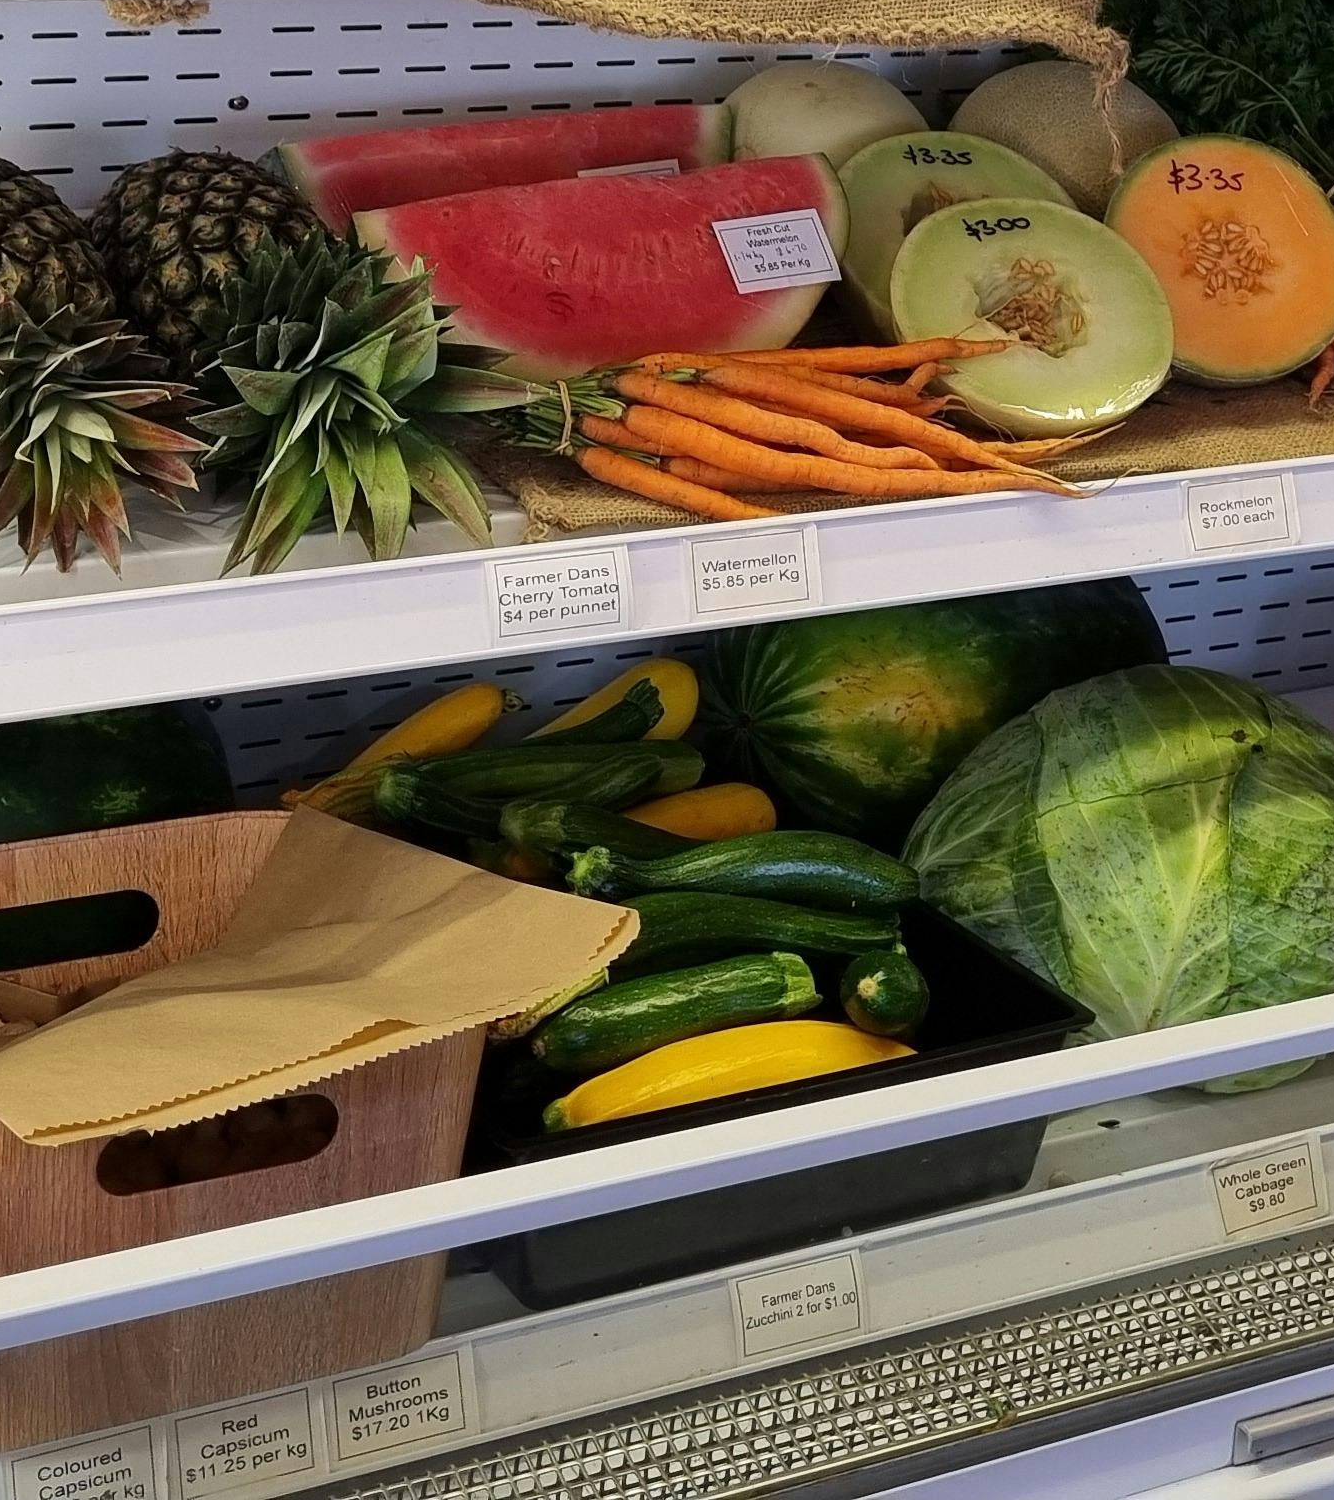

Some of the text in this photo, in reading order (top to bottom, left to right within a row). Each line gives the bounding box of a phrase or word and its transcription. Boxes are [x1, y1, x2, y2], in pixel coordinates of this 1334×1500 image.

[1167, 159, 1244, 194] $3.35
[746, 235, 799, 248] Watermelon
[747, 224, 791, 237] Fresh Cut
[962, 217, 1030, 242] $3.00
[798, 258, 811, 268] Kg
[1200, 496, 1273, 514] Rockmelon
[1202, 510, 1275, 529] $7.00 each
[702, 554, 796, 573] Watermellon
[503, 566, 610, 588] Farmer Dans
[702, 569, 800, 591] $5.85 per Kg
[499, 582, 618, 606] Cherry Tomato
[503, 598, 617, 624] $4 per punnet
[1219, 1157, 1307, 1189] Whole Green
[1235, 1176, 1294, 1200] Cabbage
[1249, 1192, 1285, 1213] $9.80
[761, 1282, 836, 1308] Farmer Dans
[746, 1291, 856, 1330] Zucchini 2 for $1.00
[367, 1377, 421, 1399] Button
[349, 1388, 449, 1423] Mushrooms
[222, 1414, 258, 1435] Red
[352, 1406, 449, 1441] $17.20 1Kg
[201, 1428, 289, 1459] Capsicum
[37, 1447, 122, 1481] Coloured
[186, 1443, 307, 1483] $11.25 per kg
[39, 1468, 132, 1500] Capsicum
[124, 1484, 145, 1499] kg
